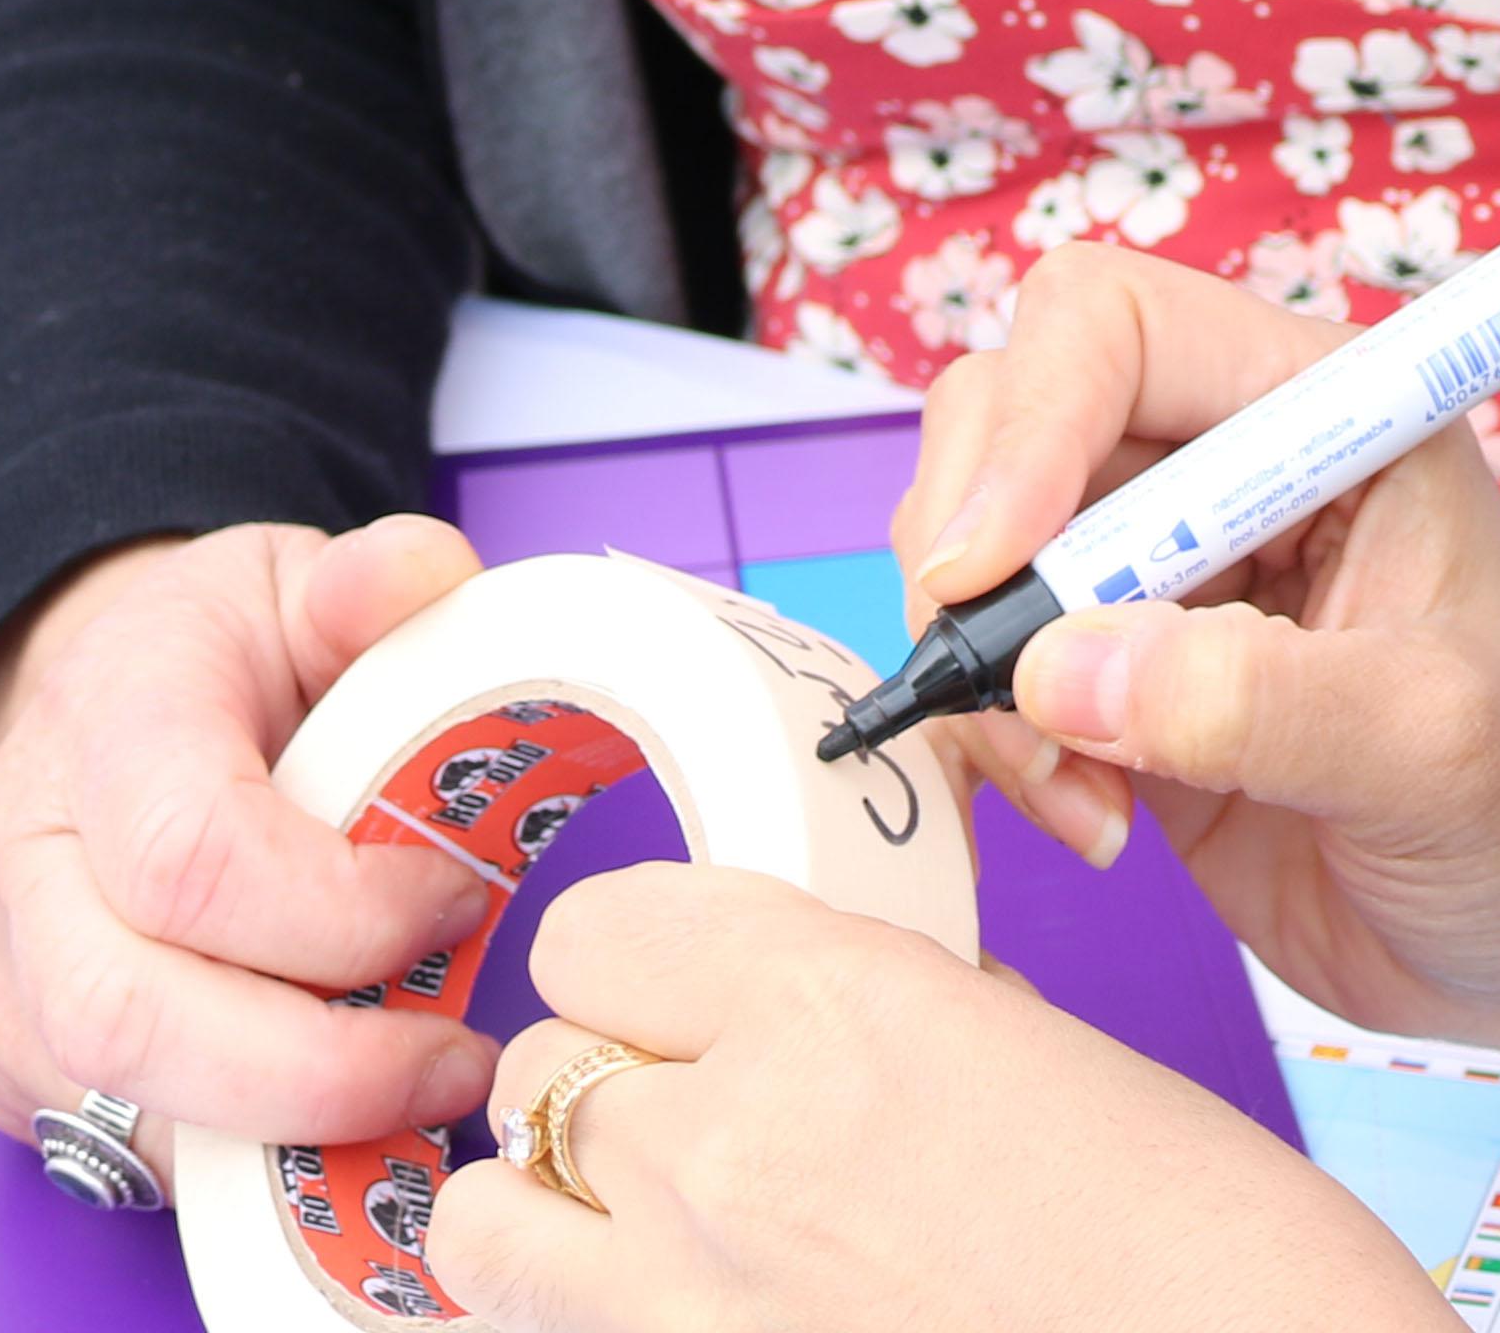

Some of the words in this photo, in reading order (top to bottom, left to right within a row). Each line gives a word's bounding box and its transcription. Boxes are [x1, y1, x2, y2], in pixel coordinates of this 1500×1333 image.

[1421, 408, 1437, 425] 4
[1208, 456, 1289, 516] nachfüllbar
[1294, 413, 1357, 460] refillable
[1219, 479, 1297, 536] recargable
[1302, 415, 1397, 483] rechargeable
[1182, 555, 1210, 579] mm
[292, 1145, 338, 1232] ROXO
